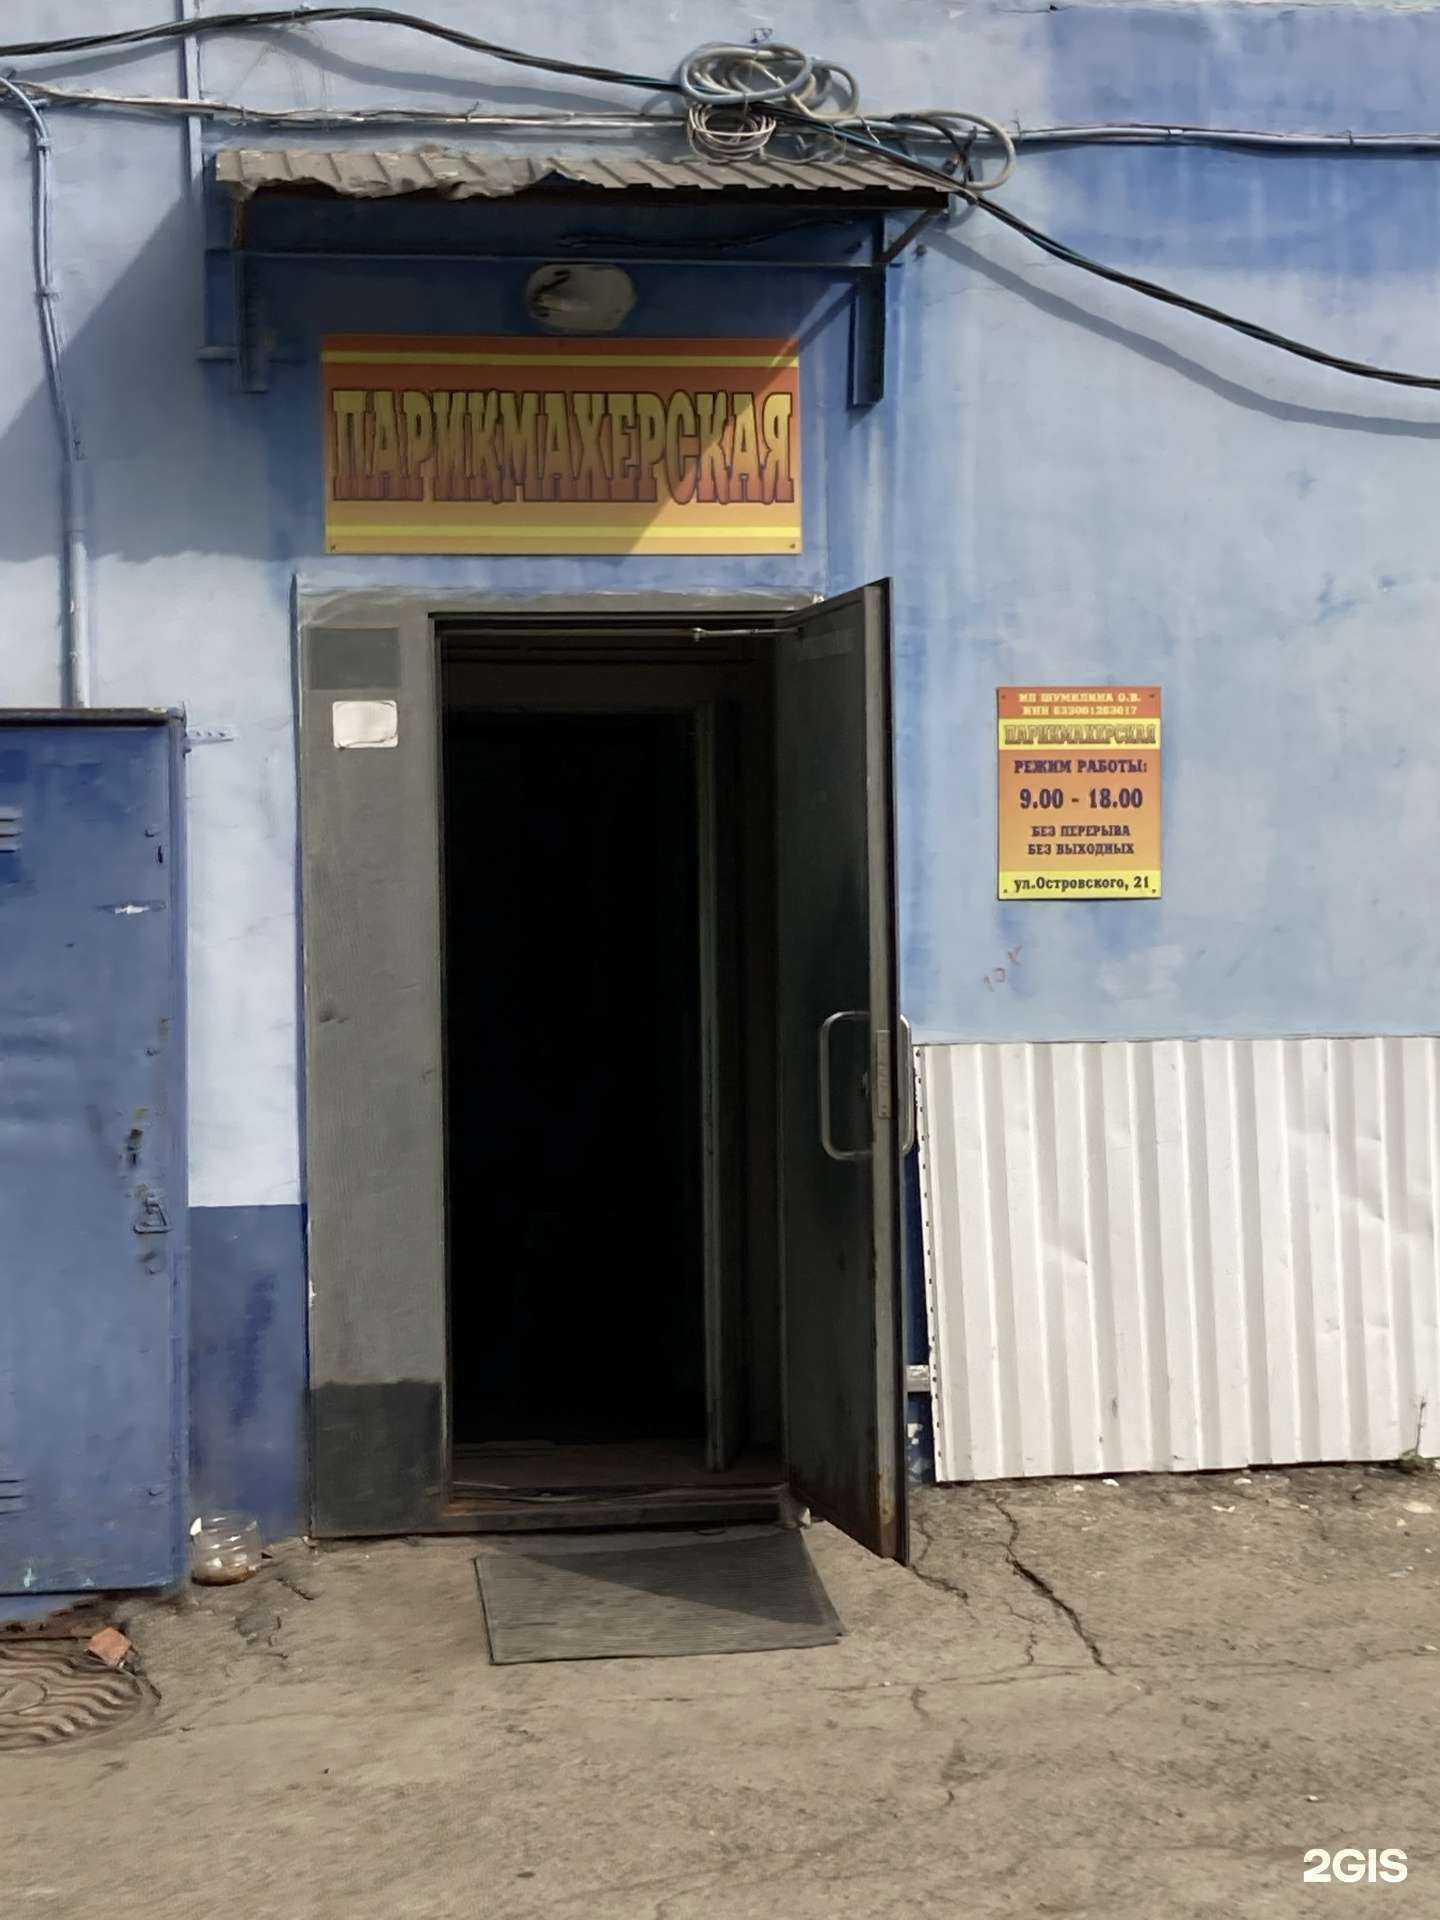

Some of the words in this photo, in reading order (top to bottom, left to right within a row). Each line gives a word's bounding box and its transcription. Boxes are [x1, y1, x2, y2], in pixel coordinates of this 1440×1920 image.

[332, 388, 795, 504] ПАРИКМАХЕРСКАЯ
[1004, 723, 1157, 745] ПАРИКМАХЕРСКАЯ
[1014, 759, 1072, 774] РЕЖИМ
[1077, 759, 1148, 774] РАБОТЫ:
[1019, 788, 1064, 809] 9.00
[1089, 787, 1144, 809] 18.00
[1031, 825, 1056, 837] БЕЗ
[1060, 825, 1131, 837] ПЕРЕРЫВА
[1028, 843, 1052, 855] БЕЗ
[1056, 843, 1135, 857] ВЫХОДНЫХ
[1013, 876, 1130, 893] ул.Островского,
[1133, 876, 1150, 889] 21
